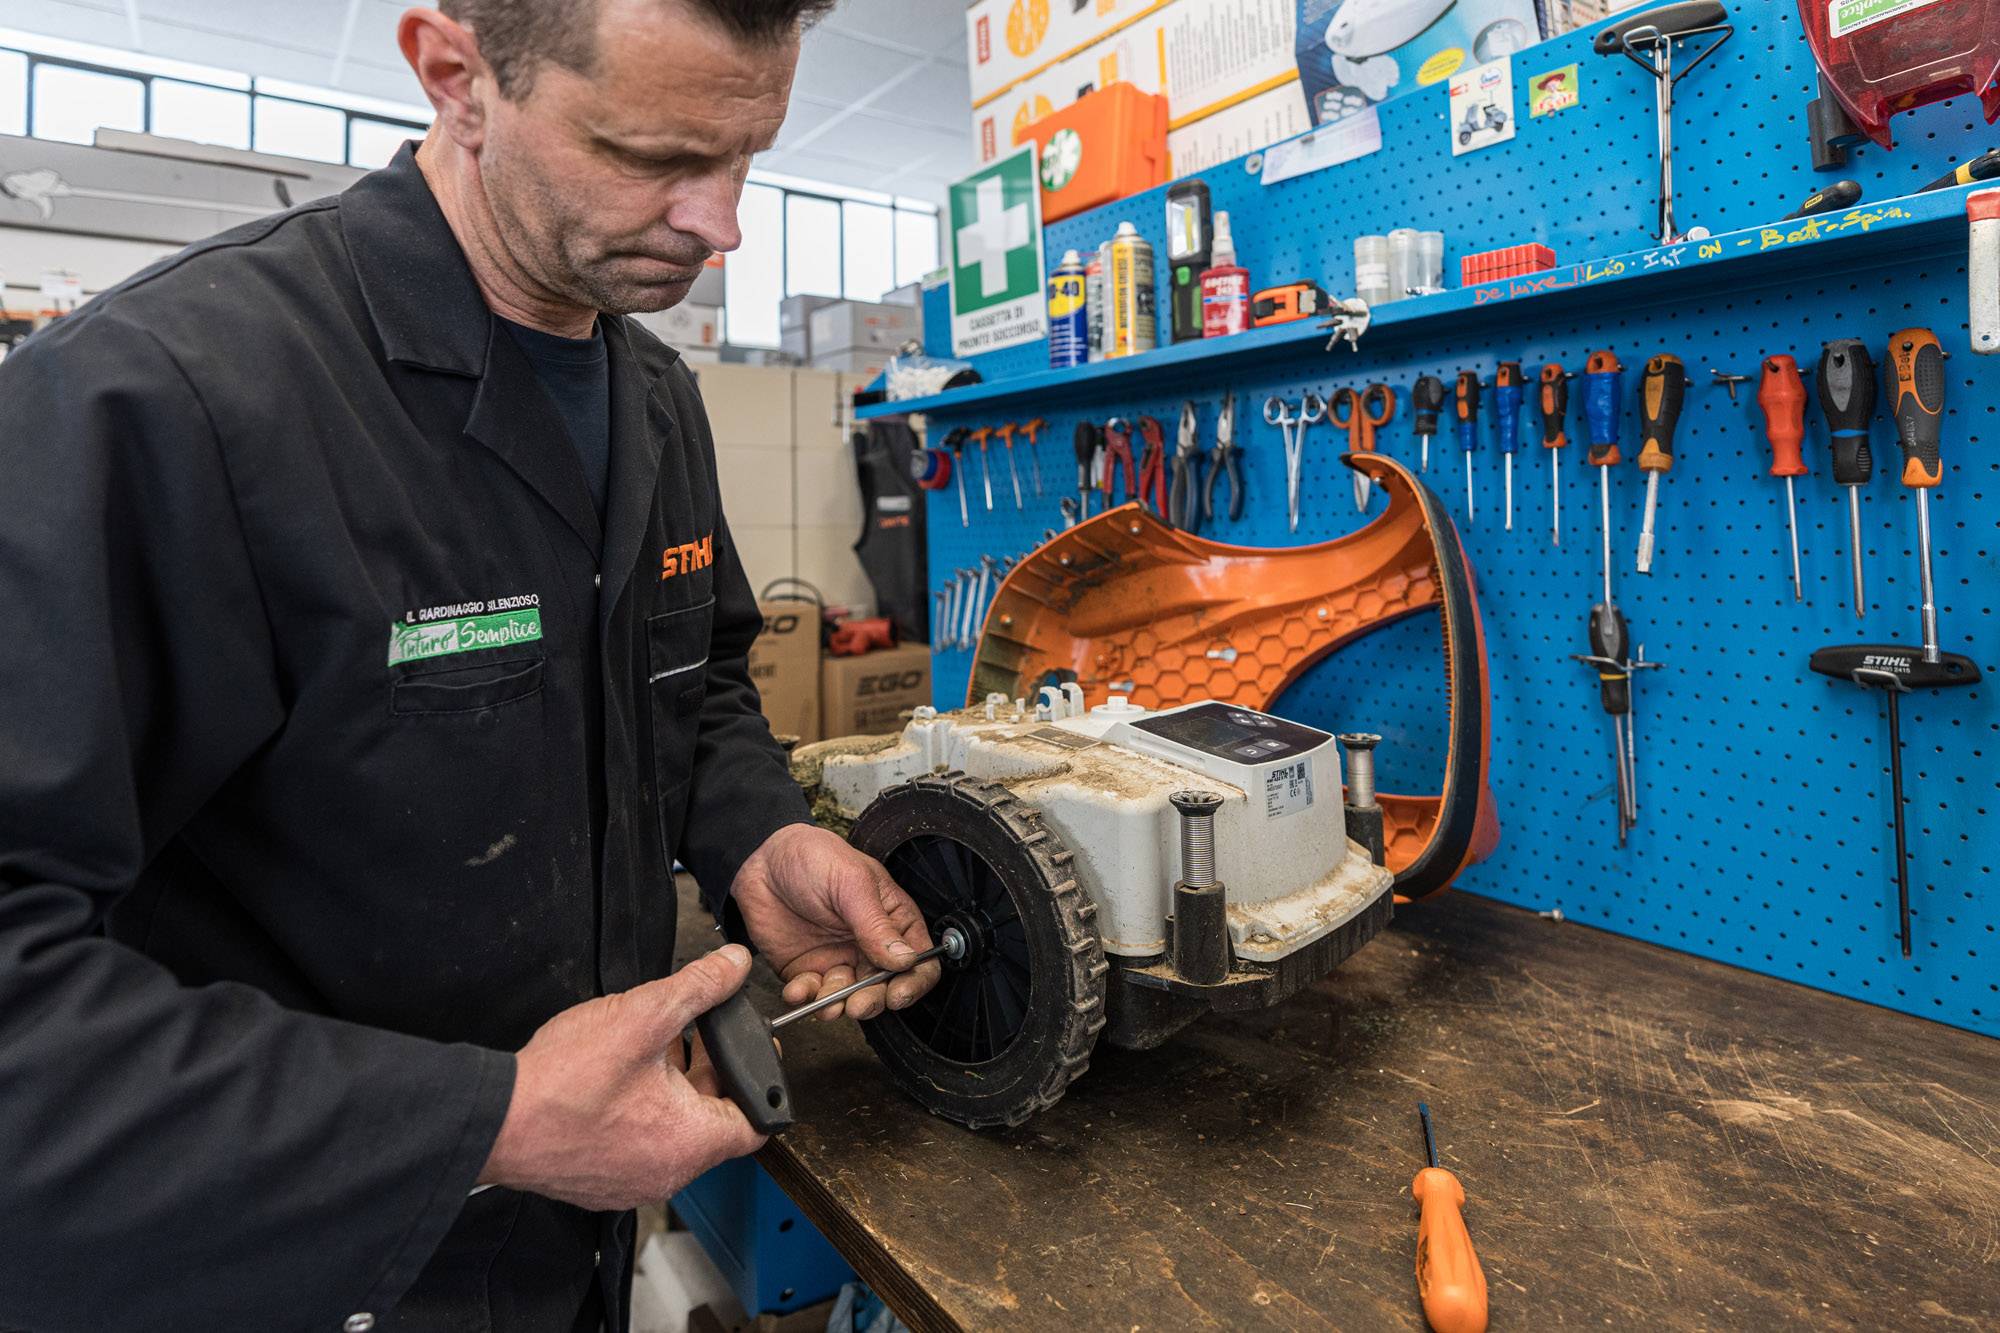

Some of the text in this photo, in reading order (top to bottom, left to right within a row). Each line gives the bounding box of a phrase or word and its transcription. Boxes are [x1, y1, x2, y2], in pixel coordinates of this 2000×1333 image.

[1698, 240, 1722, 259] ON
[969, 308, 1011, 331] CASSETTA
[959, 332, 990, 350] PRONTO
[992, 319, 1039, 341] SOCCORSO
[661, 529, 713, 580] STIH
[419, 602, 484, 620] GIARDINAGGIO
[487, 593, 540, 611] SILENZIOSO
[460, 619, 538, 648] Semplice
[1863, 655, 1910, 667] STIHL
[857, 671, 922, 696] EGO
[1272, 769, 1288, 779] STIHL
